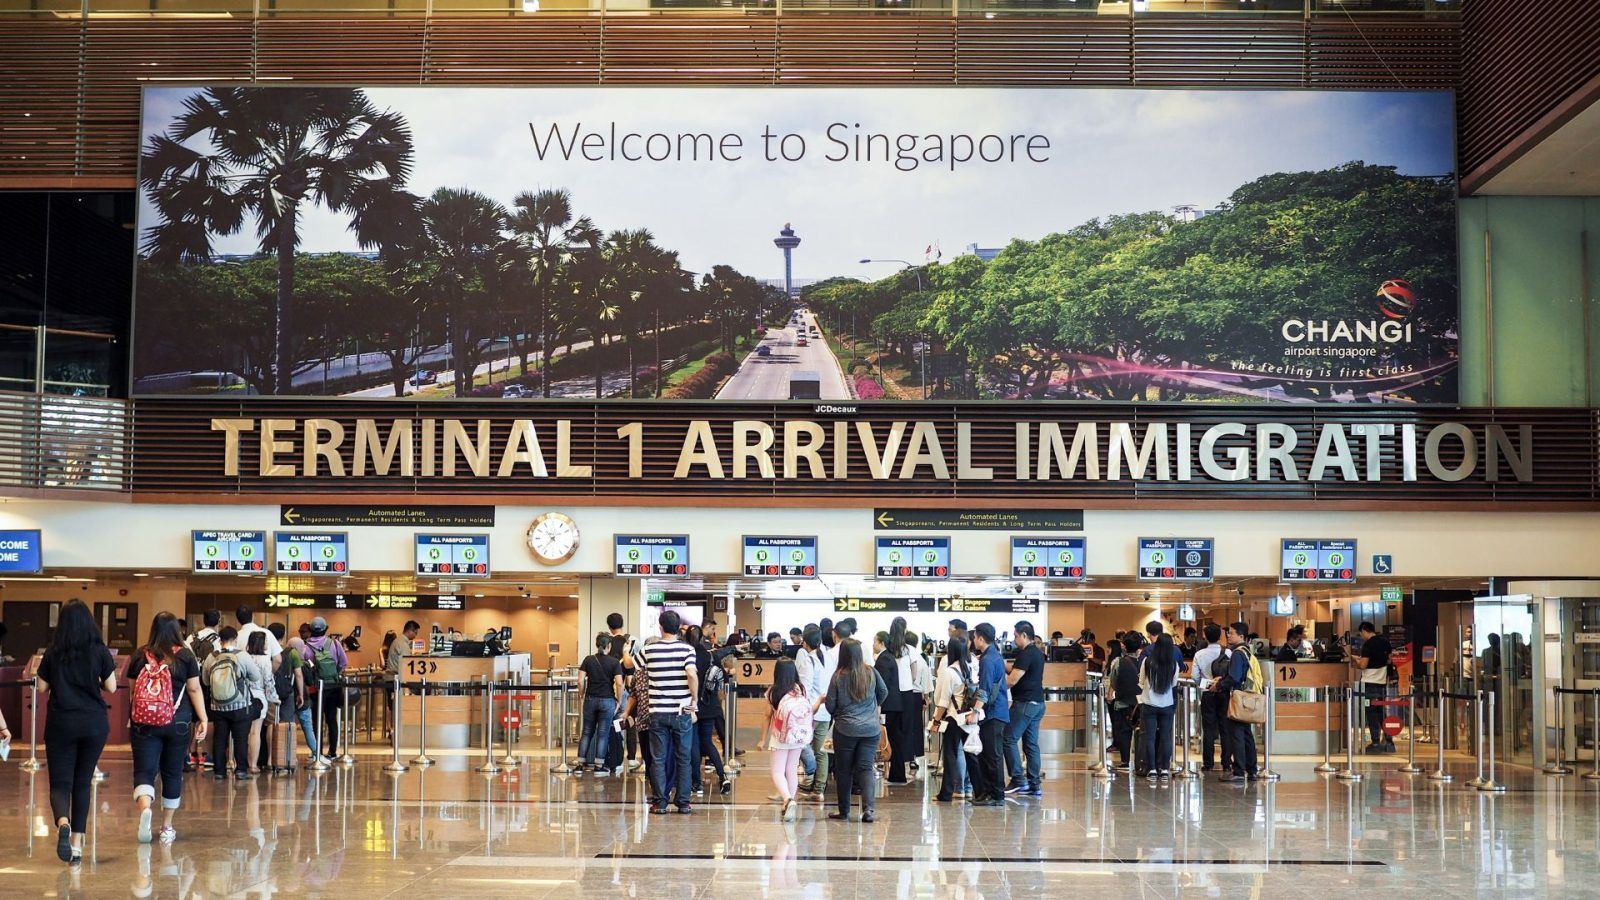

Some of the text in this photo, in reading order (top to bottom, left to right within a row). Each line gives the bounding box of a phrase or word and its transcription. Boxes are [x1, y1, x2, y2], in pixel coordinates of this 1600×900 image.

[528, 121, 1051, 172] Welcome to Singapore
[1282, 319, 1412, 343] CHANGI
[1284, 346, 1377, 358] airport singapore
[1231, 361, 1414, 378] the feeling is first class
[815, 405, 857, 413] JCDecaux
[211, 419, 1533, 483] TERMINAL 1 ARRIVAL IMMIGRATION
[368, 509, 426, 517] Automated Lanes
[959, 513, 1019, 521] Automated Lanes
[631, 550, 638, 559] 12
[666, 550, 673, 559] 11
[1296, 555, 1305, 564] 02
[1332, 555, 1340, 564] 01
[1382, 591, 1397, 600] EXIT
[860, 601, 887, 609] Baggage
[432, 635, 445, 648] 14
[938, 639, 946, 650] 8
[1256, 641, 1264, 653] 2
[407, 660, 427, 675] 13
[742, 662, 752, 677] 9
[1279, 666, 1287, 681] 1
